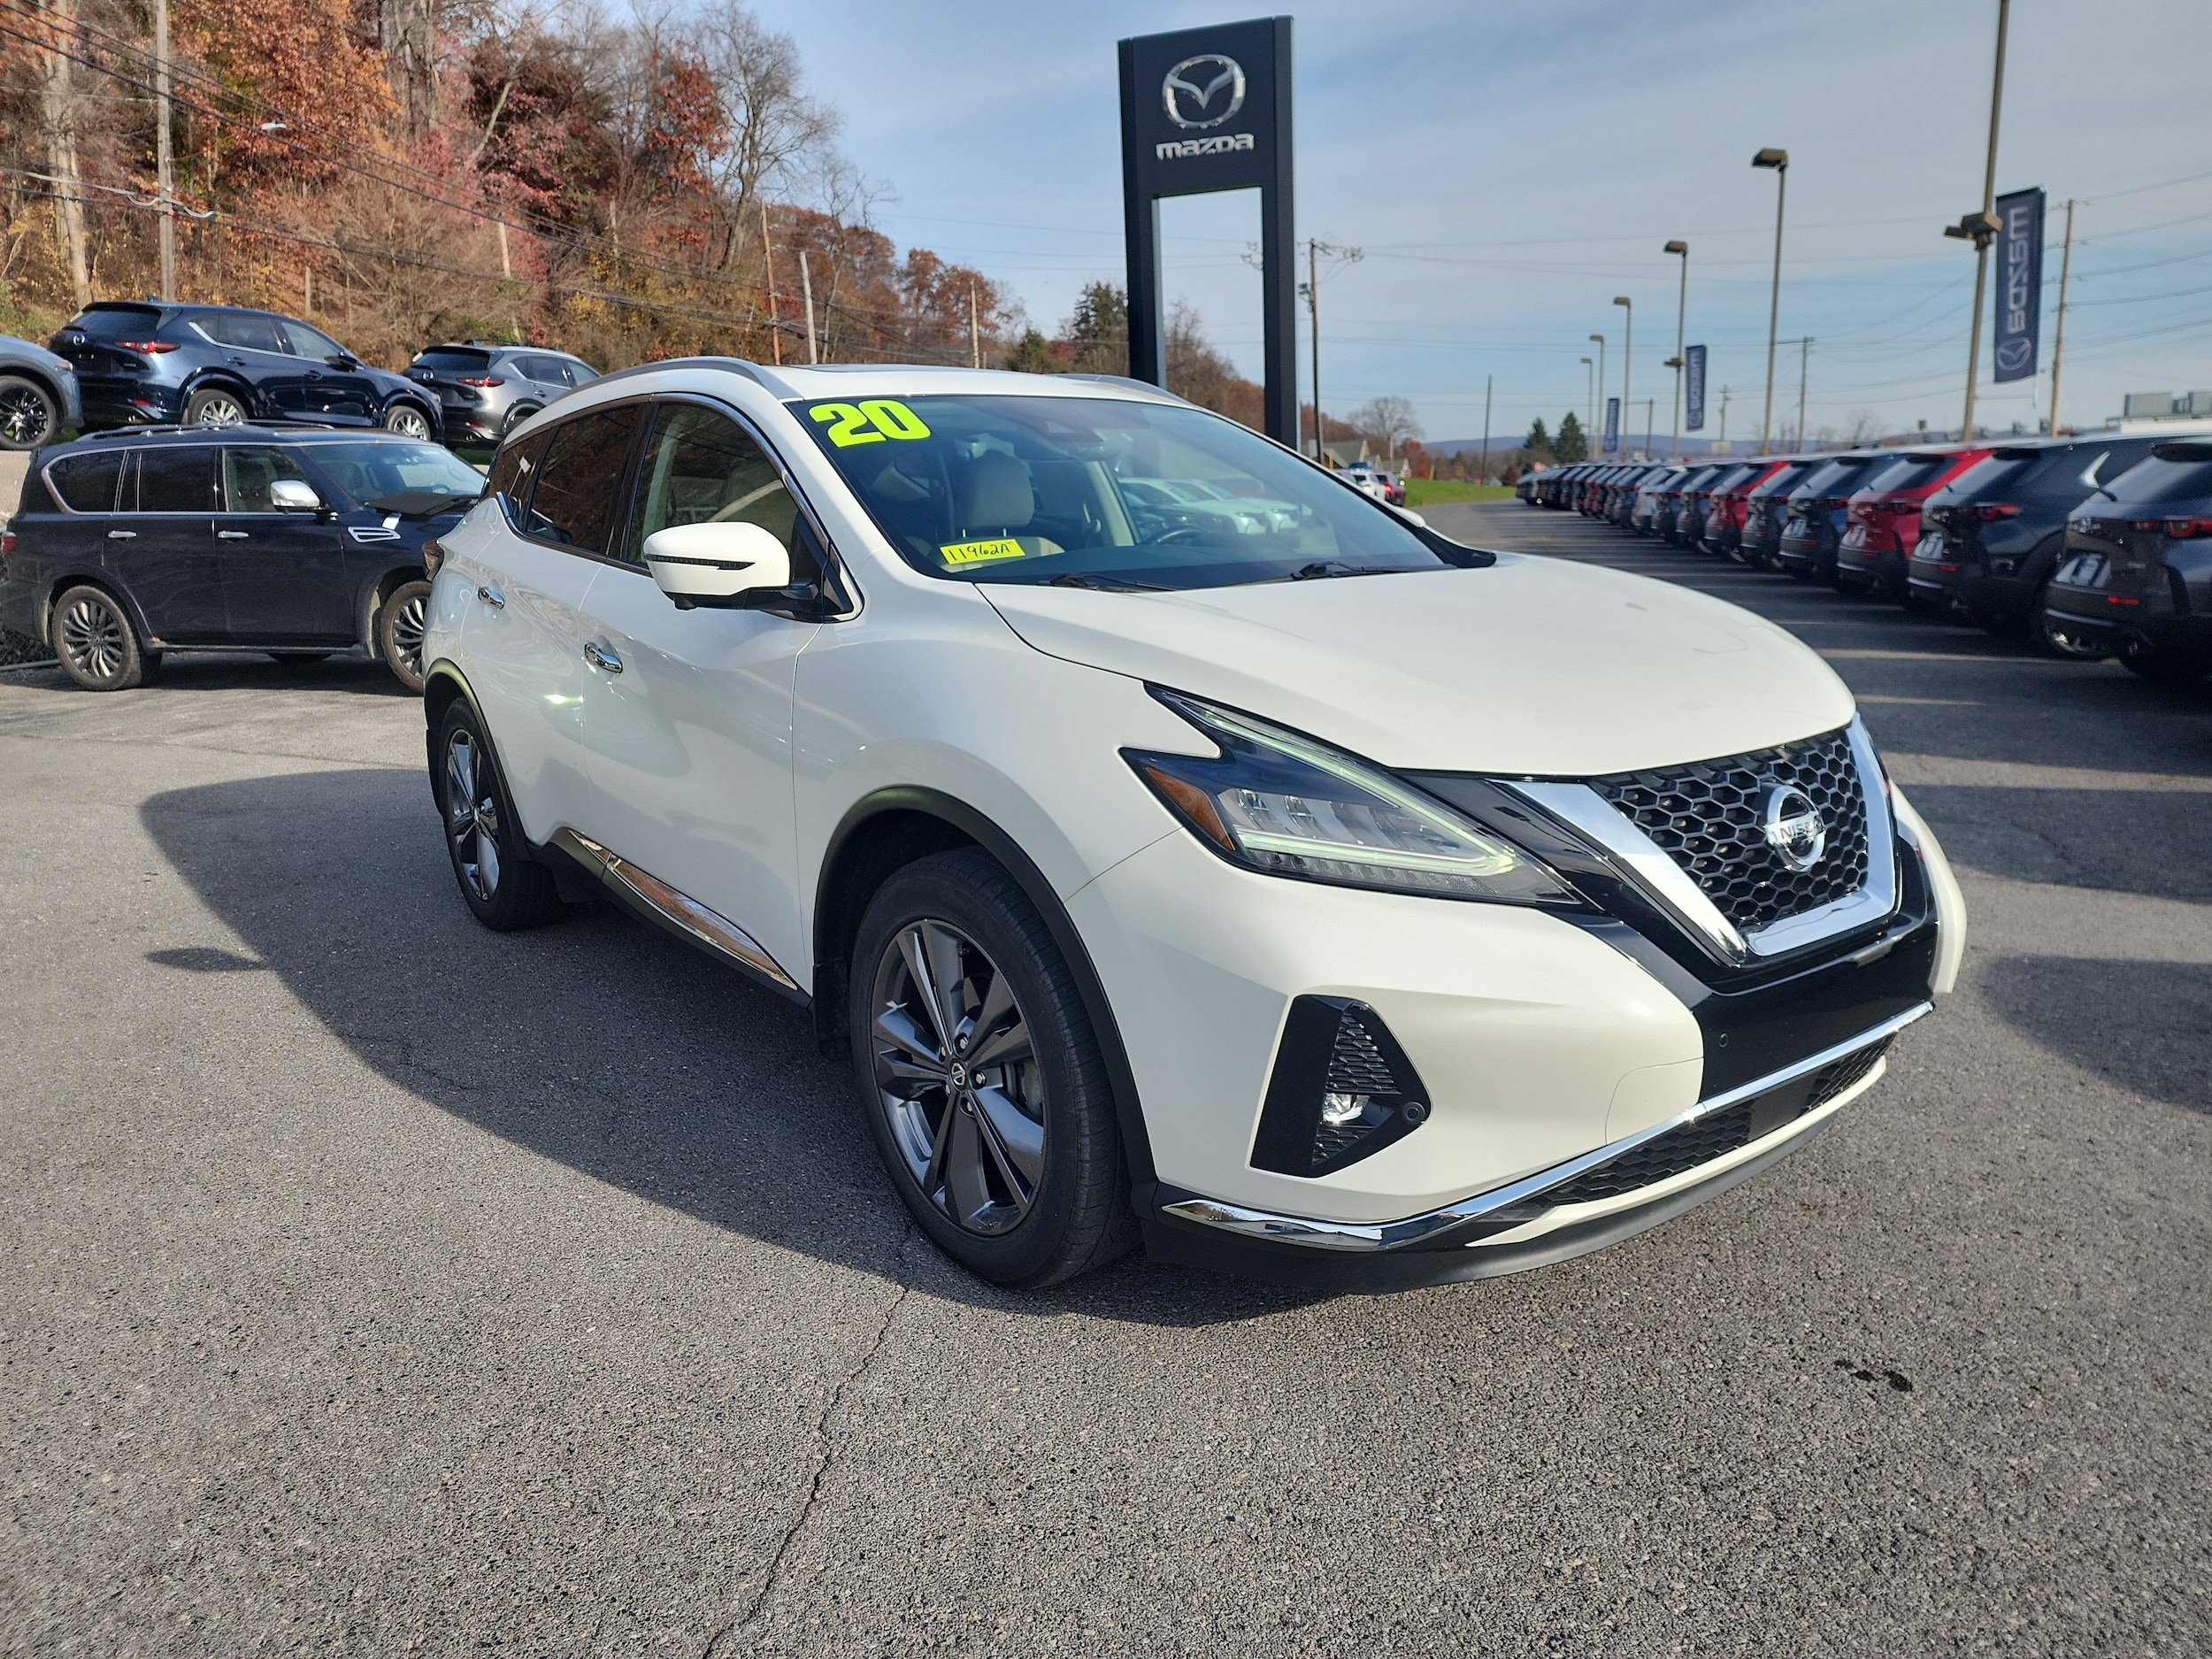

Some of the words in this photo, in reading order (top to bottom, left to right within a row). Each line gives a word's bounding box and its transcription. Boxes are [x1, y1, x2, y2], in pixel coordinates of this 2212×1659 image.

[809, 400, 932, 448] 20
[949, 543, 1010, 561] 11962A
[1779, 815, 1823, 840] NISS
